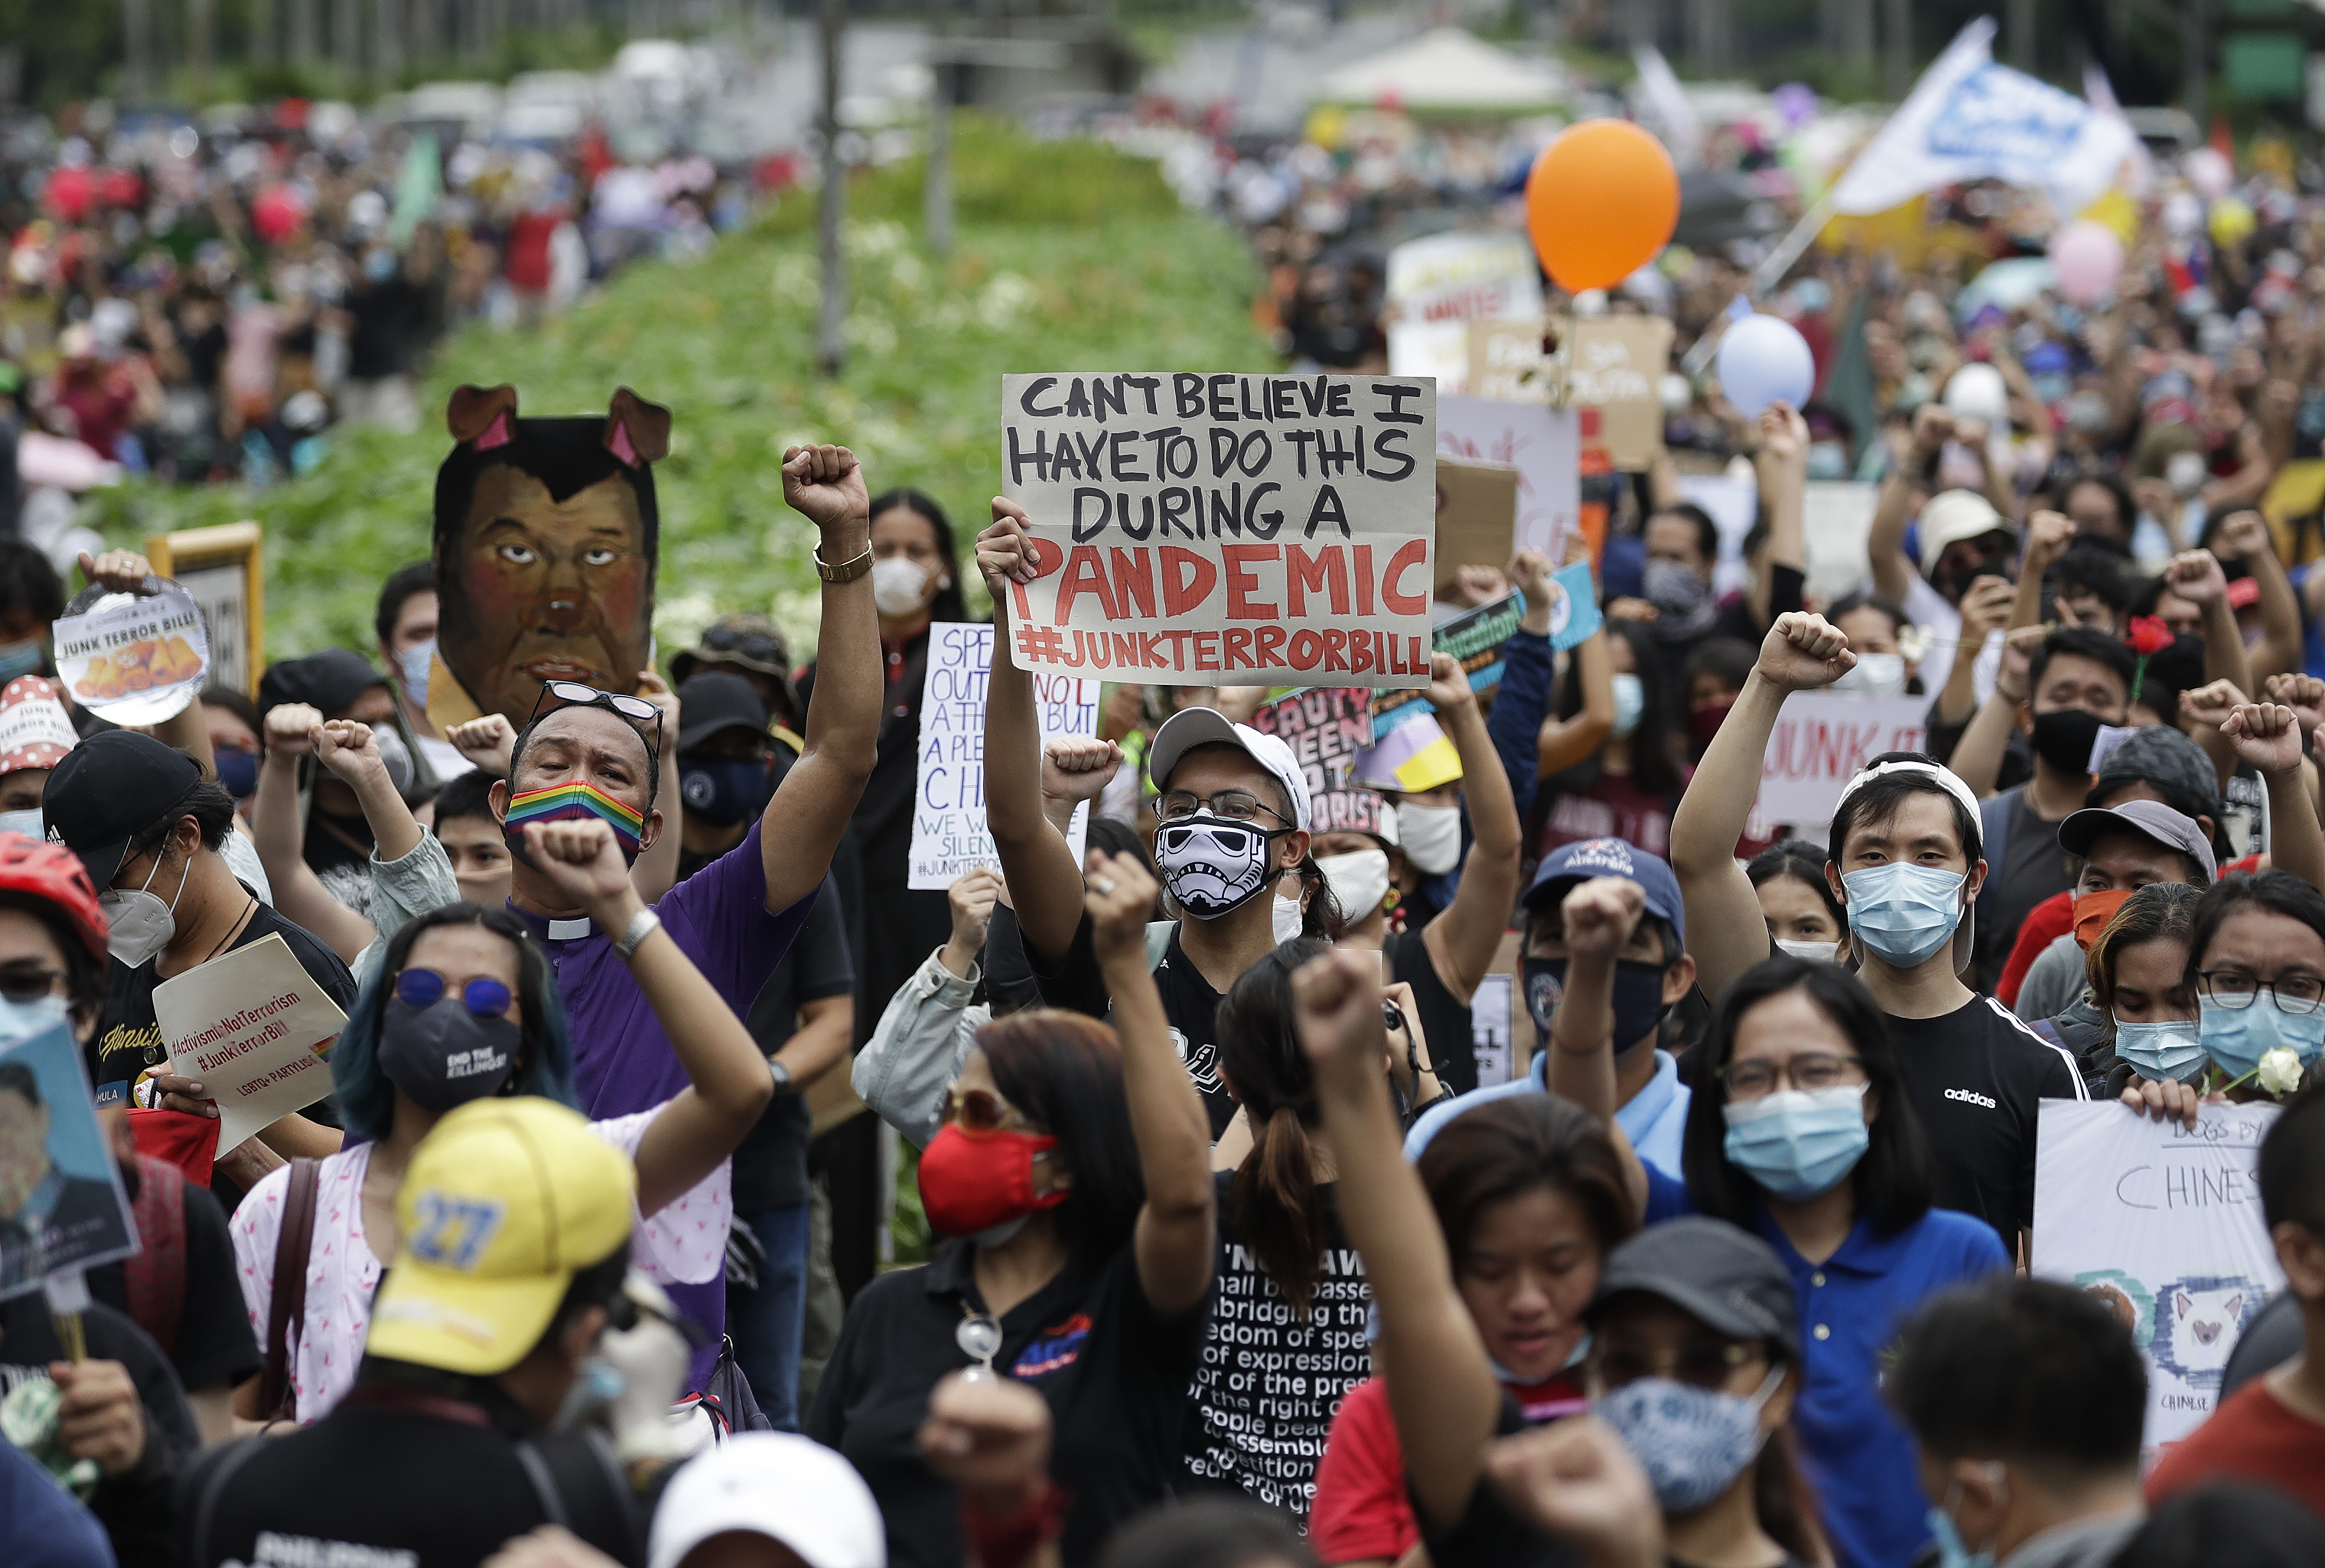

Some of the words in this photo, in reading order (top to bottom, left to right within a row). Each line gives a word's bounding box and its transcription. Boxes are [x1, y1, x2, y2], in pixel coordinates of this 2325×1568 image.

[1173, 373, 1355, 424] BELIEVE
[1371, 384, 1424, 425] I
[1209, 427, 1272, 478] DO
[1284, 425, 1415, 482] THIS
[1071, 482, 1284, 543] DURING
[1303, 484, 1351, 539] A
[1010, 536, 1427, 626] PANDEMIC
[63, 635, 101, 658] JUNK
[103, 621, 159, 648] TERROR
[942, 628, 994, 669] SPE
[1016, 624, 1430, 676] #JUNKTERRORBILL
[931, 668, 990, 701] OUT
[930, 702, 950, 731] A
[955, 702, 985, 731] TH
[1047, 702, 1095, 734] BUT
[1251, 687, 1371, 737] EAUTY
[923, 736, 943, 763] A
[952, 734, 983, 762] PLE
[1762, 719, 1880, 782] JUNK
[1301, 751, 1354, 797] OT
[919, 814, 956, 835] WE
[1309, 791, 1383, 834] ORIST
[937, 835, 997, 858] SILEN
[236, 1078, 271, 1097] LGBTQ+
[268, 1054, 318, 1083] PARTYLIST
[1944, 1088, 1997, 1109] adidas
[2116, 1164, 2259, 1210] CHINES
[410, 1189, 506, 1275] 27
[1206, 1321, 1278, 1346] edom
[1287, 1326, 1315, 1347] of
[1202, 1345, 1230, 1365] of
[1237, 1350, 1371, 1373] expression
[1196, 1367, 1222, 1387] or
[1229, 1372, 1257, 1392] of
[1263, 1372, 1307, 1396] the
[1200, 1404, 1267, 1436] eople
[1210, 1389, 1251, 1410] the
[1258, 1396, 1322, 1420] right
